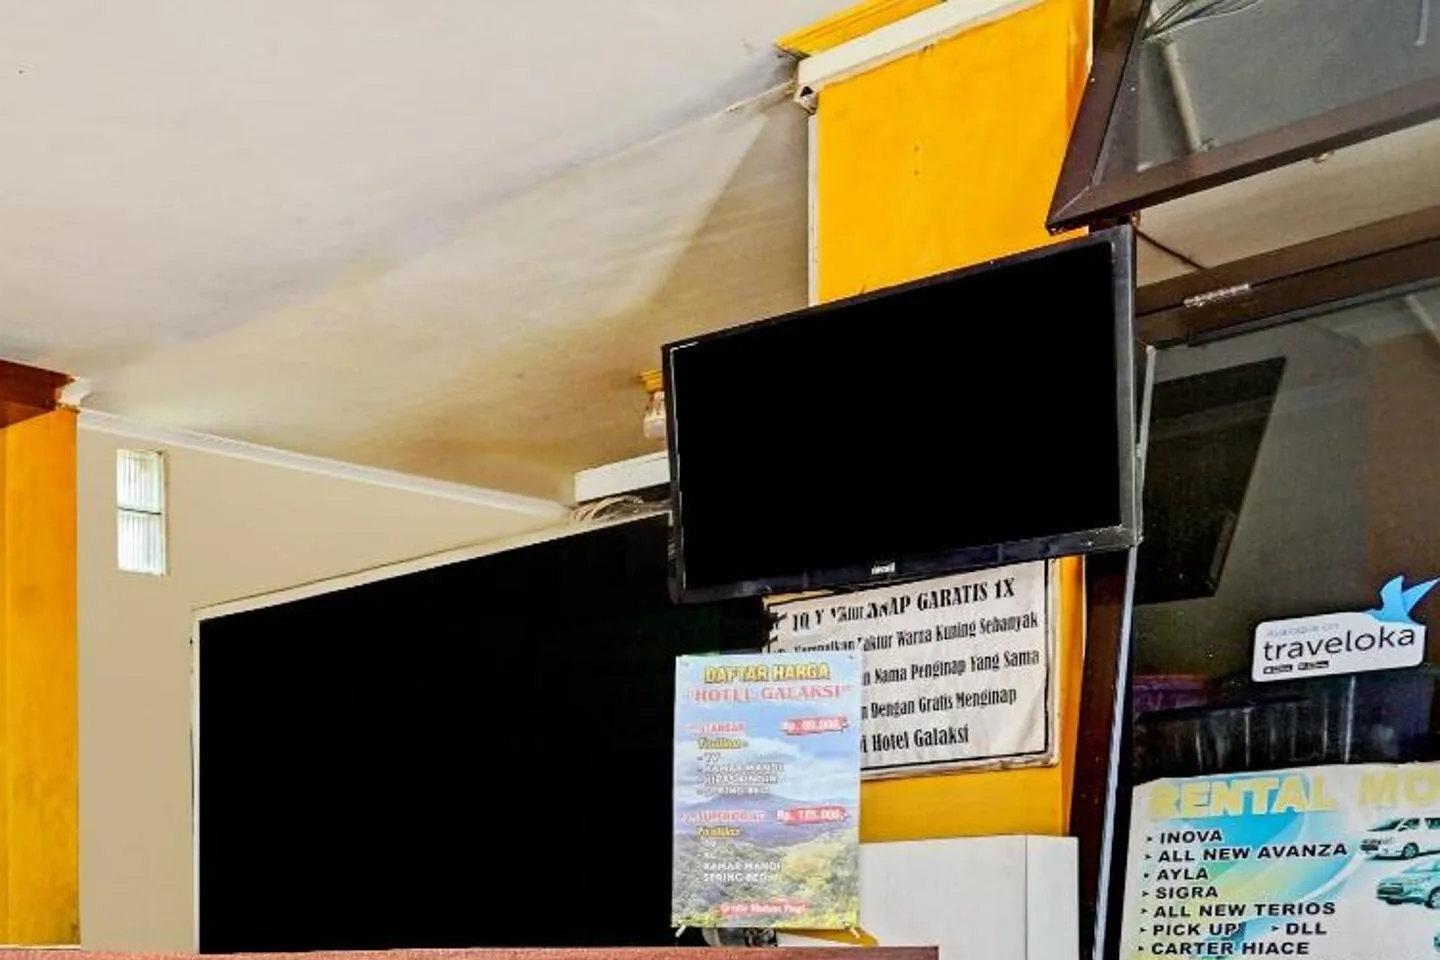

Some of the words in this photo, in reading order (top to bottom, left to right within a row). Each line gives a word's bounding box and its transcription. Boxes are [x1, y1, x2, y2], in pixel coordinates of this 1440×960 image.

[917, 582, 988, 612] GARATIS
[994, 577, 1015, 599] 1X
[1263, 626, 1415, 661] traveloka
[705, 665, 769, 685] DAFTAR
[773, 662, 831, 682] HARGA
[875, 667, 907, 684] Nama
[970, 653, 1000, 672] Yang
[1004, 649, 1040, 668] Sama
[871, 699, 915, 719] Dengan
[919, 692, 953, 713] Gratis
[955, 687, 1017, 708] Menginap
[873, 731, 910, 751] Hotel
[914, 723, 969, 747] Galaksi
[1147, 774, 1338, 820] RENTAL
[1160, 830, 1223, 844] INOVA
[1159, 849, 1195, 862] ALL
[1202, 847, 1250, 861] NEW
[1257, 843, 1348, 859] AVANZA
[1157, 867, 1209, 881] AYLA
[1155, 886, 1218, 900] SIGRA
[1153, 906, 1192, 918] ALL
[1199, 904, 1246, 917] NEW
[1254, 902, 1336, 916] TERIOS
[1153, 924, 1201, 937] PICK
[1286, 922, 1328, 936] DLL
[1151, 942, 1234, 956] CARTER
[1242, 941, 1310, 956] HIACE
